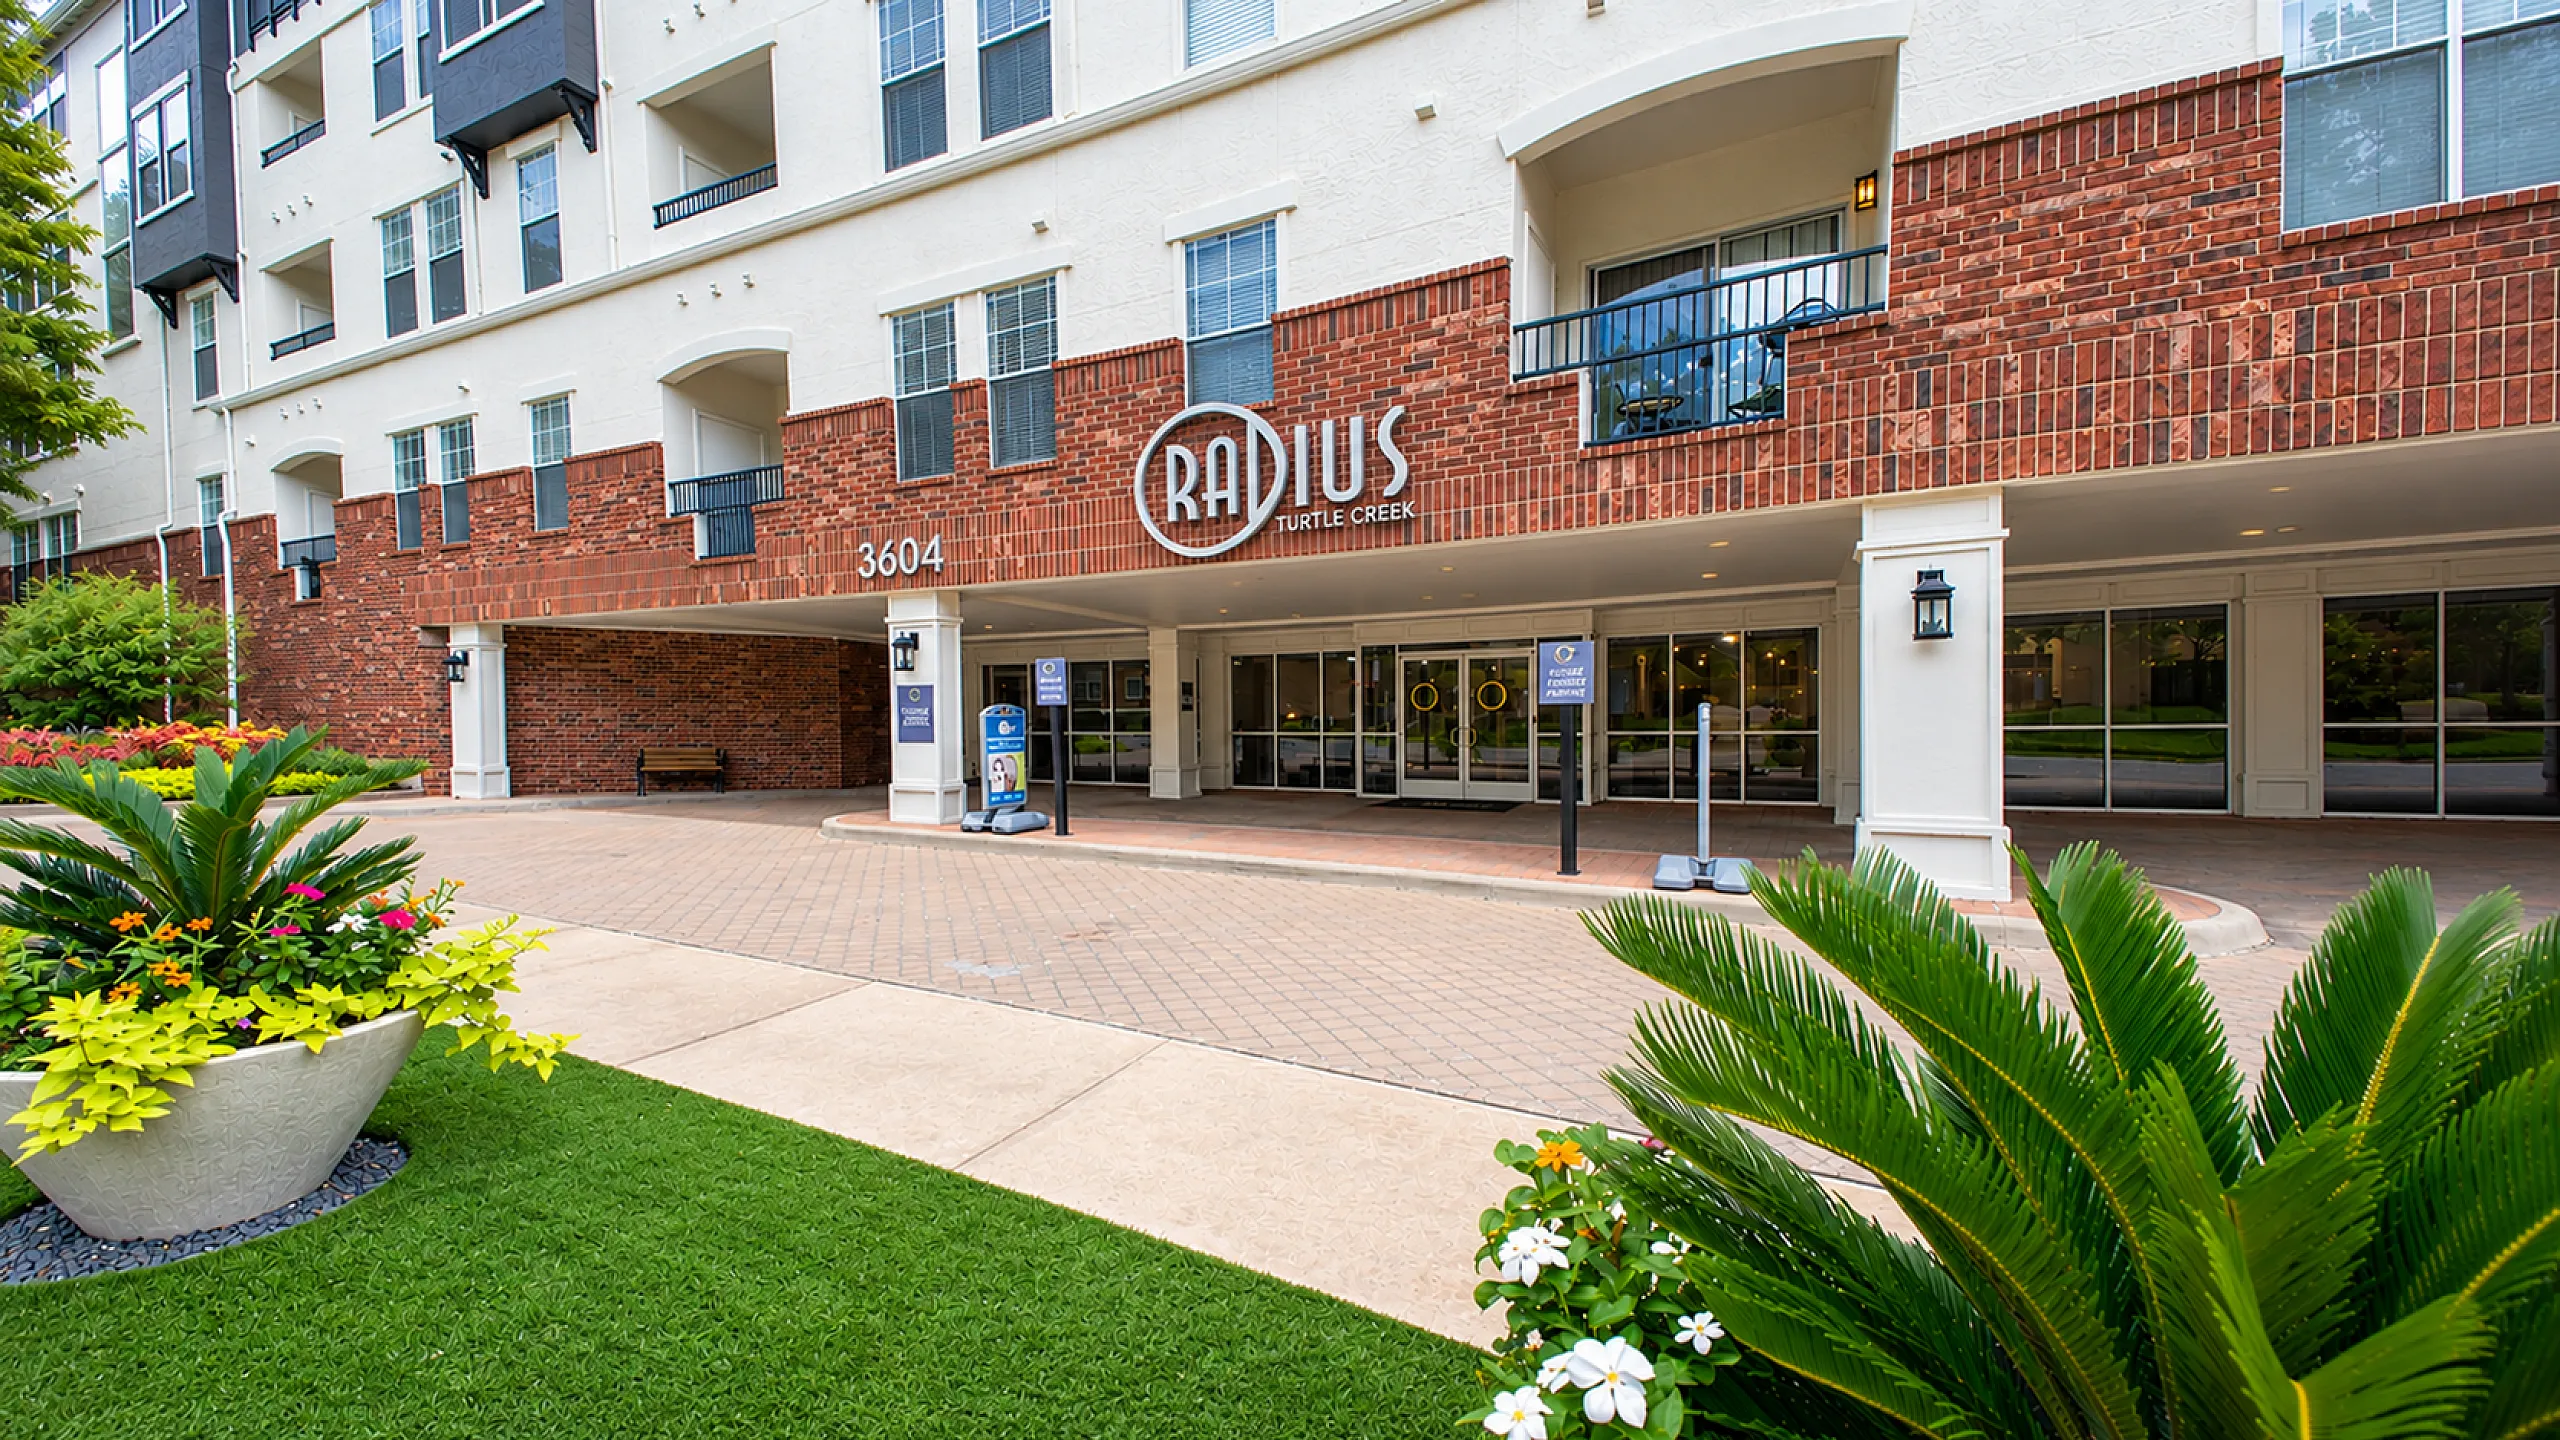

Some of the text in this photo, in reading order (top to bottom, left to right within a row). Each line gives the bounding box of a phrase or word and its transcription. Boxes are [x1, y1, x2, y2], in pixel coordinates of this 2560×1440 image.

[1134, 402, 1409, 557] RADIUS
[1276, 501, 1416, 533] TURTLE CREEK
[858, 532, 944, 578] 3604
